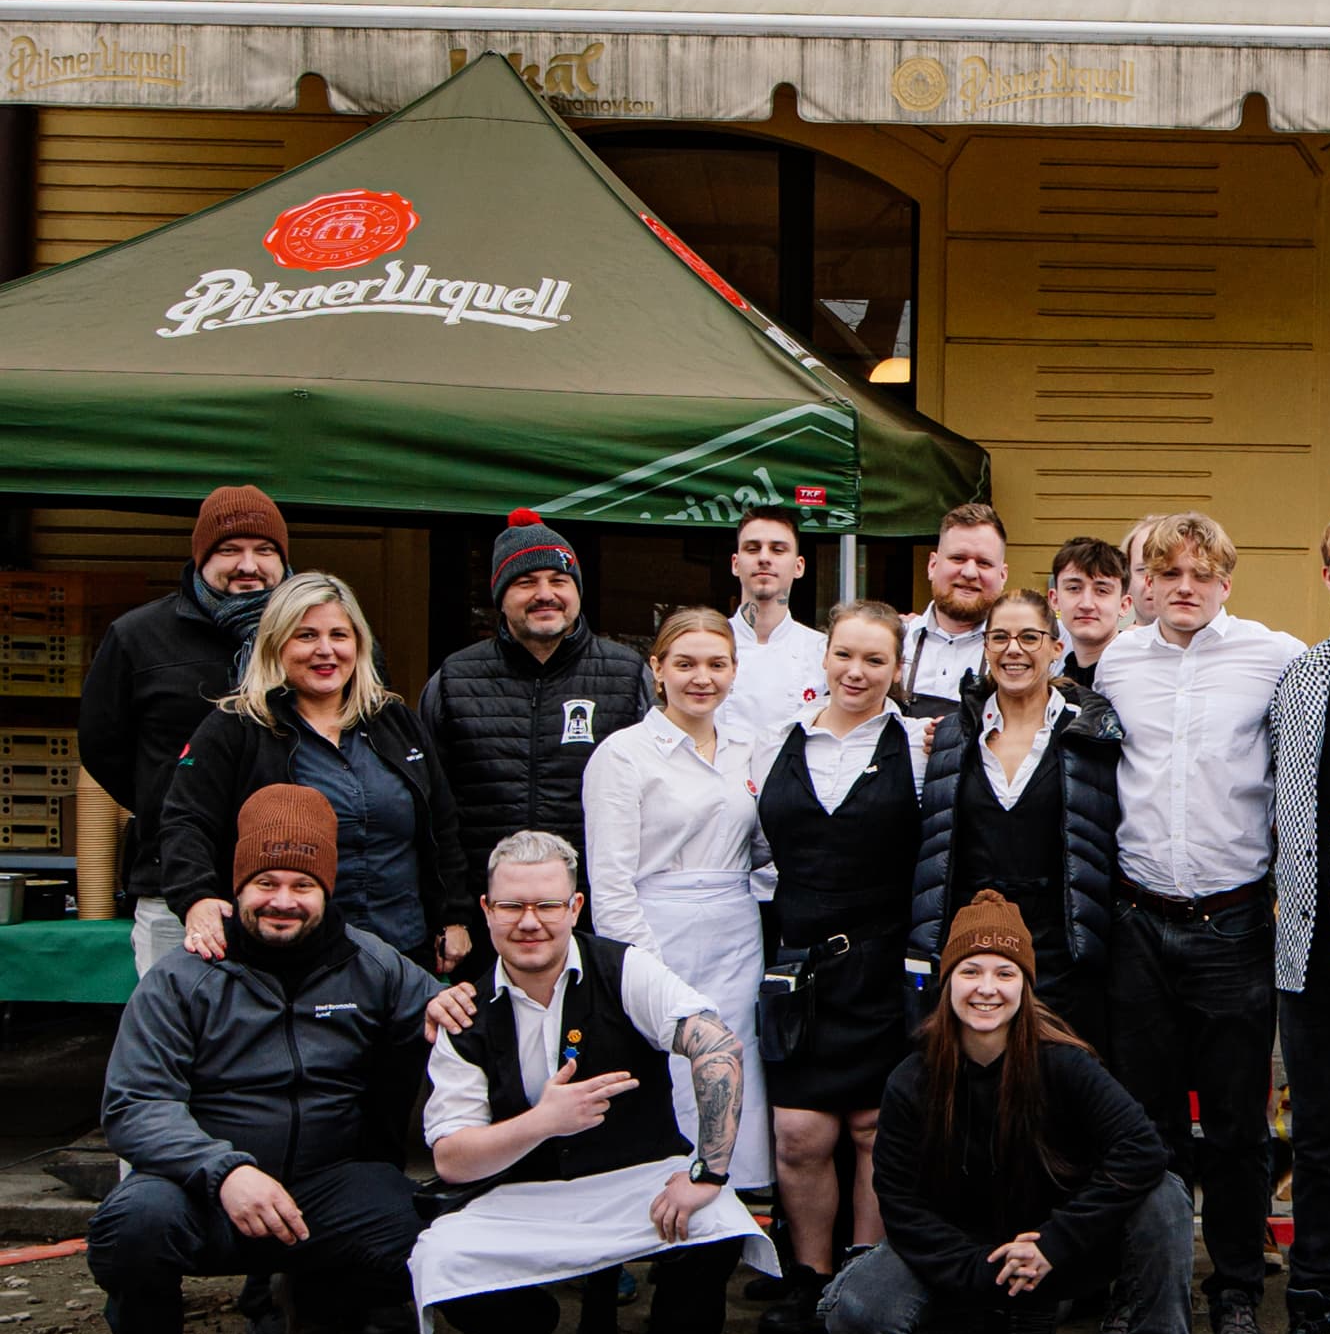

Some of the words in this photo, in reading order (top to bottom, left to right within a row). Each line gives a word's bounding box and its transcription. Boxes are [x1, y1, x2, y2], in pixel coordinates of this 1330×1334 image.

[6, 35, 101, 95] Pilsner
[98, 36, 187, 91] Urquell
[959, 55, 1050, 116] Pilsner
[1047, 54, 1135, 103] Urquell
[156, 269, 386, 338] Pilsner
[378, 260, 572, 326] Urquell
[800, 489, 822, 498] TKF
